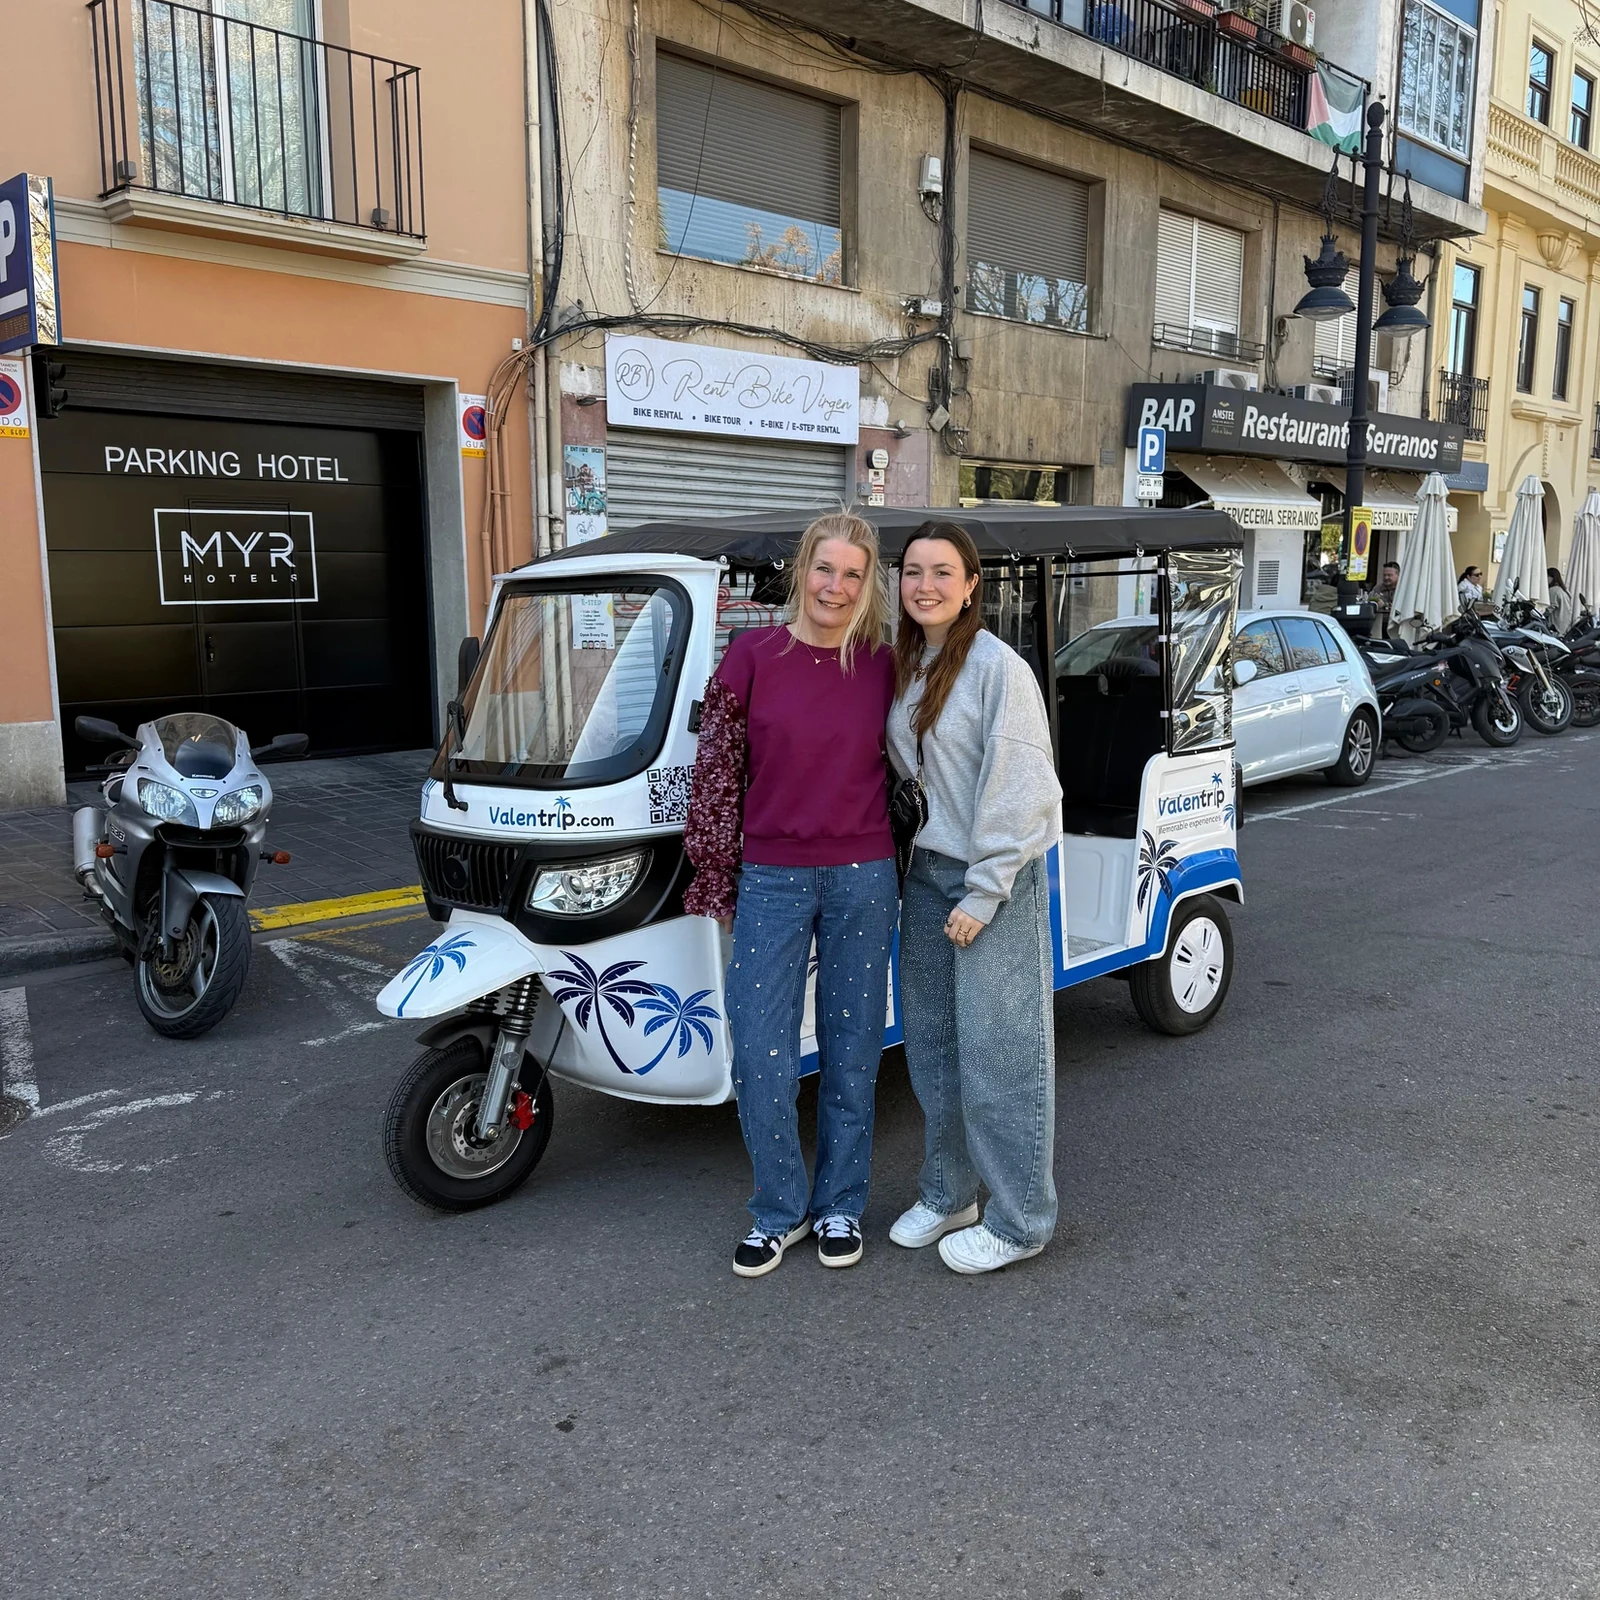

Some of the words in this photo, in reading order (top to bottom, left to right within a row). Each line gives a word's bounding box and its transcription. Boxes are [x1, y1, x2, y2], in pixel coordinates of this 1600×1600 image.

[662, 358, 733, 405] Rent
[733, 364, 795, 408] Bike
[793, 370, 852, 421] Virgen
[633, 407, 652, 418] BIKE
[654, 409, 683, 420] RENTAL
[704, 414, 721, 424] BIKE
[722, 415, 741, 425] TOUR
[760, 420, 784, 429] E-BIKE
[792, 422, 815, 432] E-STEP
[816, 425, 840, 434] RENTAL
[1140, 398, 1195, 432] BAR
[1212, 409, 1235, 421] AMSTEL
[1241, 405, 1350, 449] Restaurant
[1365, 423, 1438, 460] Serranos
[105, 446, 241, 477] PARKING
[257, 453, 349, 482] HOTEL
[1144, 434, 1160, 467] P
[1221, 507, 1274, 525] ERVECERIA
[1277, 510, 1319, 526] SERRANOS
[180, 531, 296, 568] MYR
[184, 574, 298, 583] HOTELS
[1159, 780, 1225, 816] Valentrip
[489, 799, 615, 830] Valentrip.com
[1158, 821, 1188, 835] Memorable
[1189, 815, 1221, 828] experiences
